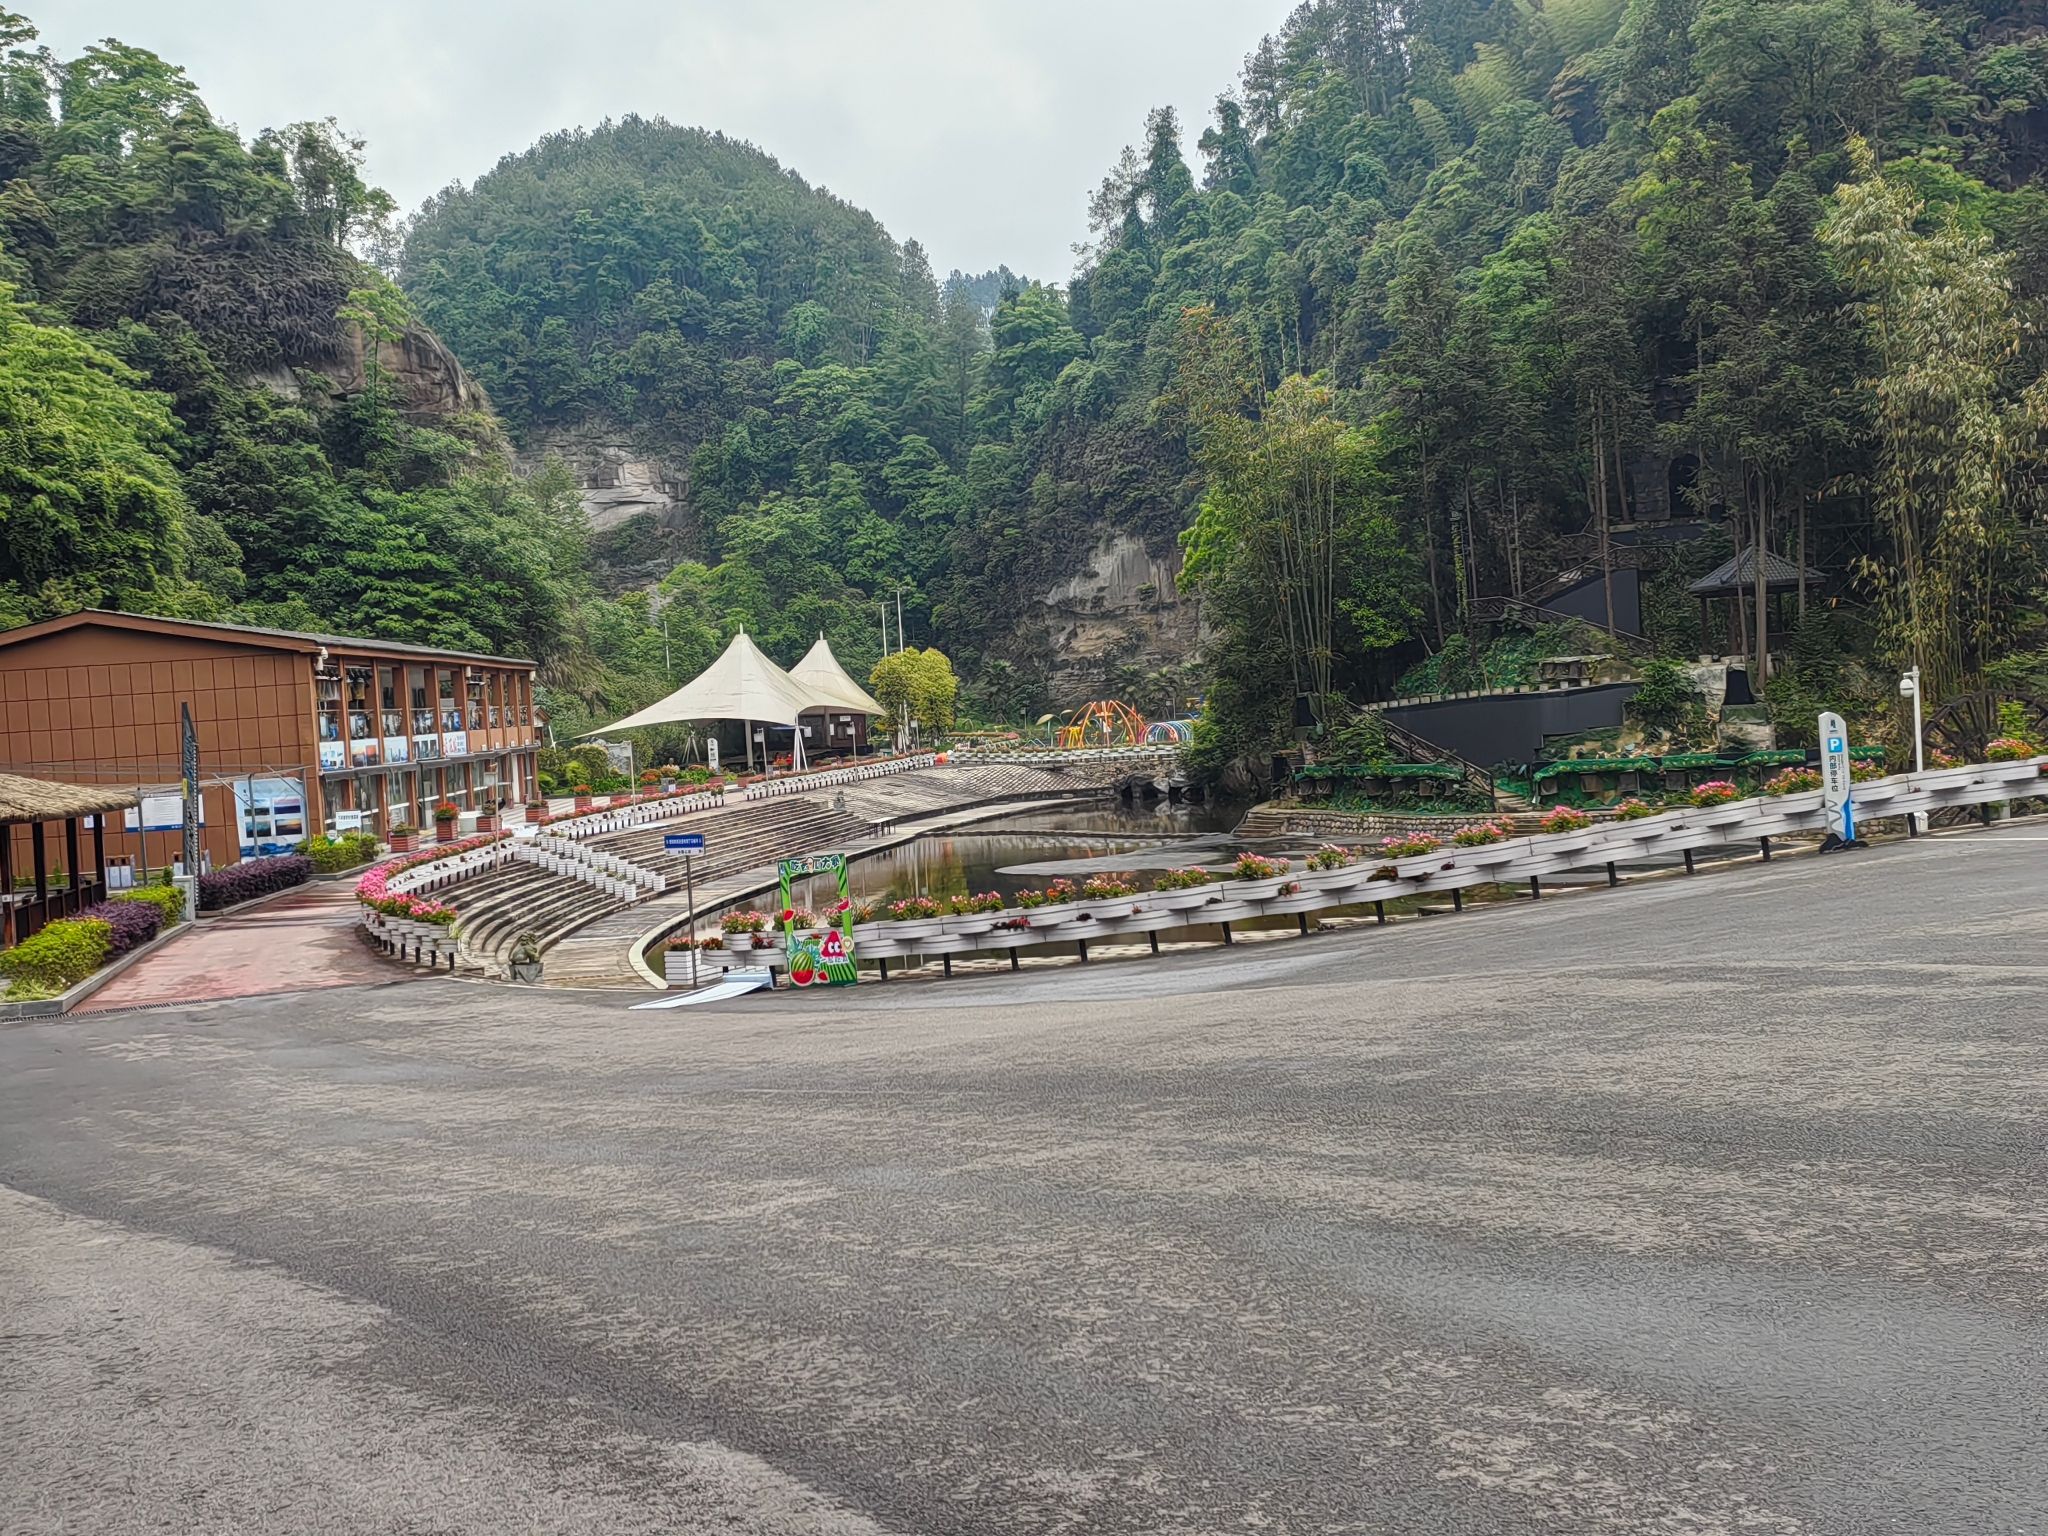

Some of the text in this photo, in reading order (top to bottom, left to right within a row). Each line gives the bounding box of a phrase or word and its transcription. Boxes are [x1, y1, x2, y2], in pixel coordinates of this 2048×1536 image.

[1830, 739, 1839, 751] P
[1829, 755, 1839, 792] 内部停车位
